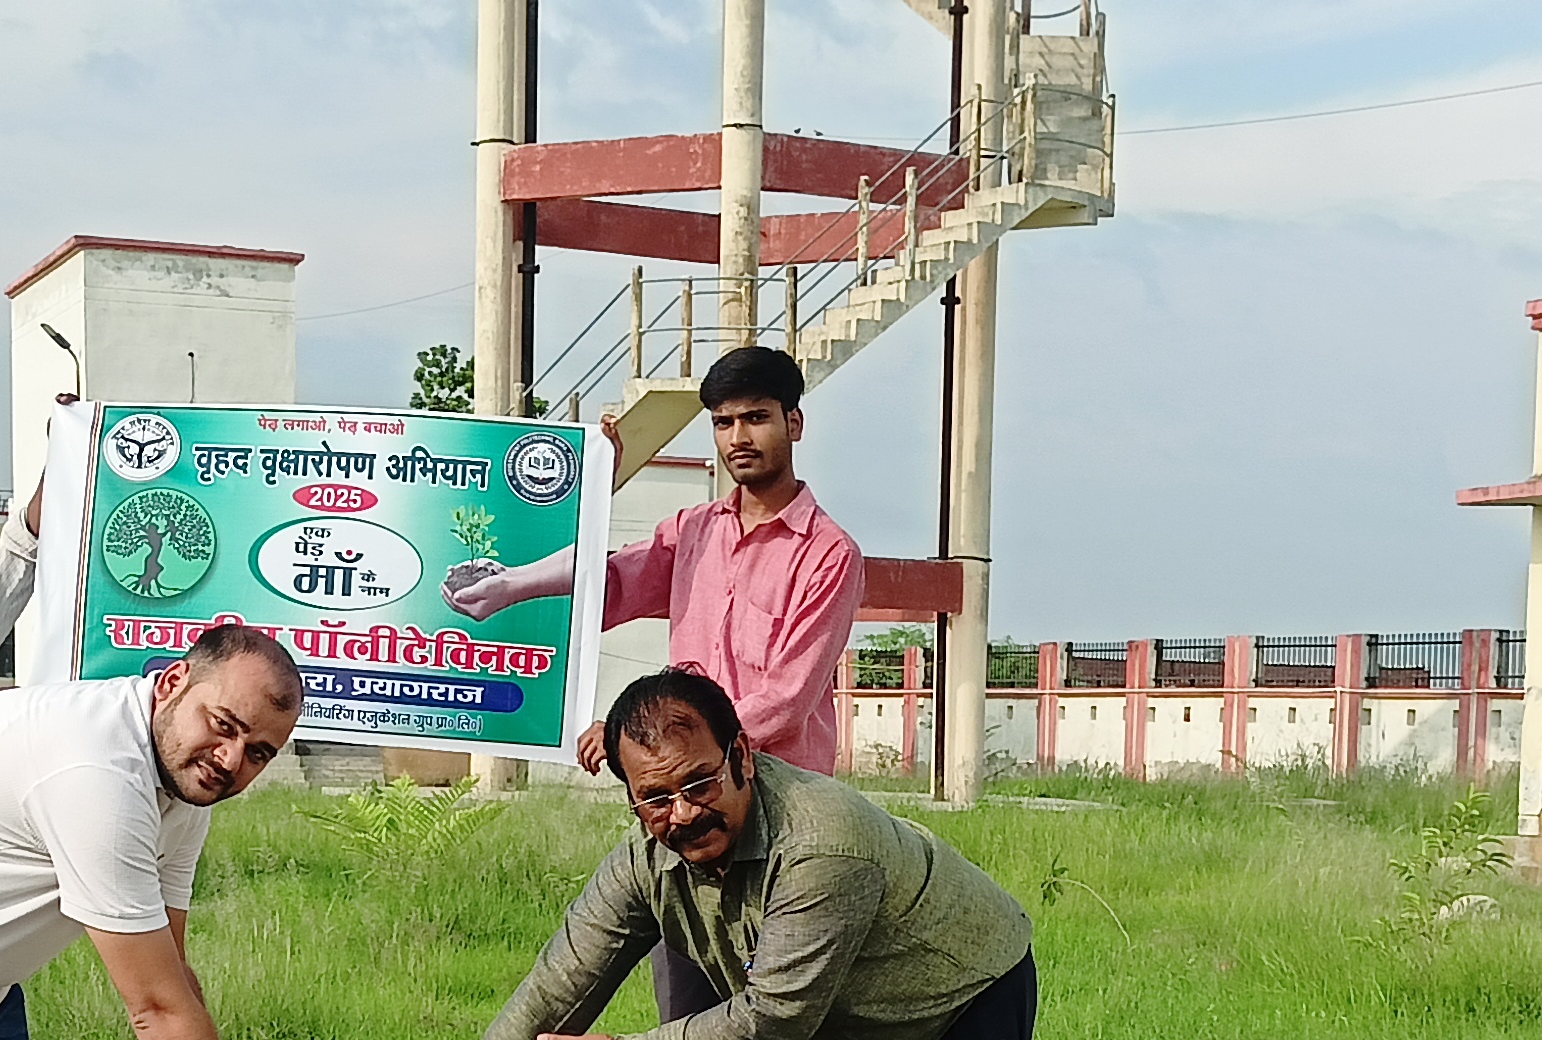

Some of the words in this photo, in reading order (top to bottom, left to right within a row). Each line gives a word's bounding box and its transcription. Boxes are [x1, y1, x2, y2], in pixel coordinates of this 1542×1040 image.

[282, 415, 332, 434] लगाओ,
[362, 419, 406, 436] बचाओ
[194, 446, 252, 482] वृहद
[259, 440, 377, 485] वृक्षारोपण
[385, 446, 490, 488] अभियान
[309, 487, 362, 508] 2025
[303, 526, 332, 540] एक
[294, 535, 325, 561] पेड़
[292, 549, 364, 597] माँ
[359, 569, 377, 583] के
[358, 585, 390, 597] नाम
[289, 619, 554, 676] पॉलीटेक्निक
[350, 675, 485, 704] प्रयागराज
